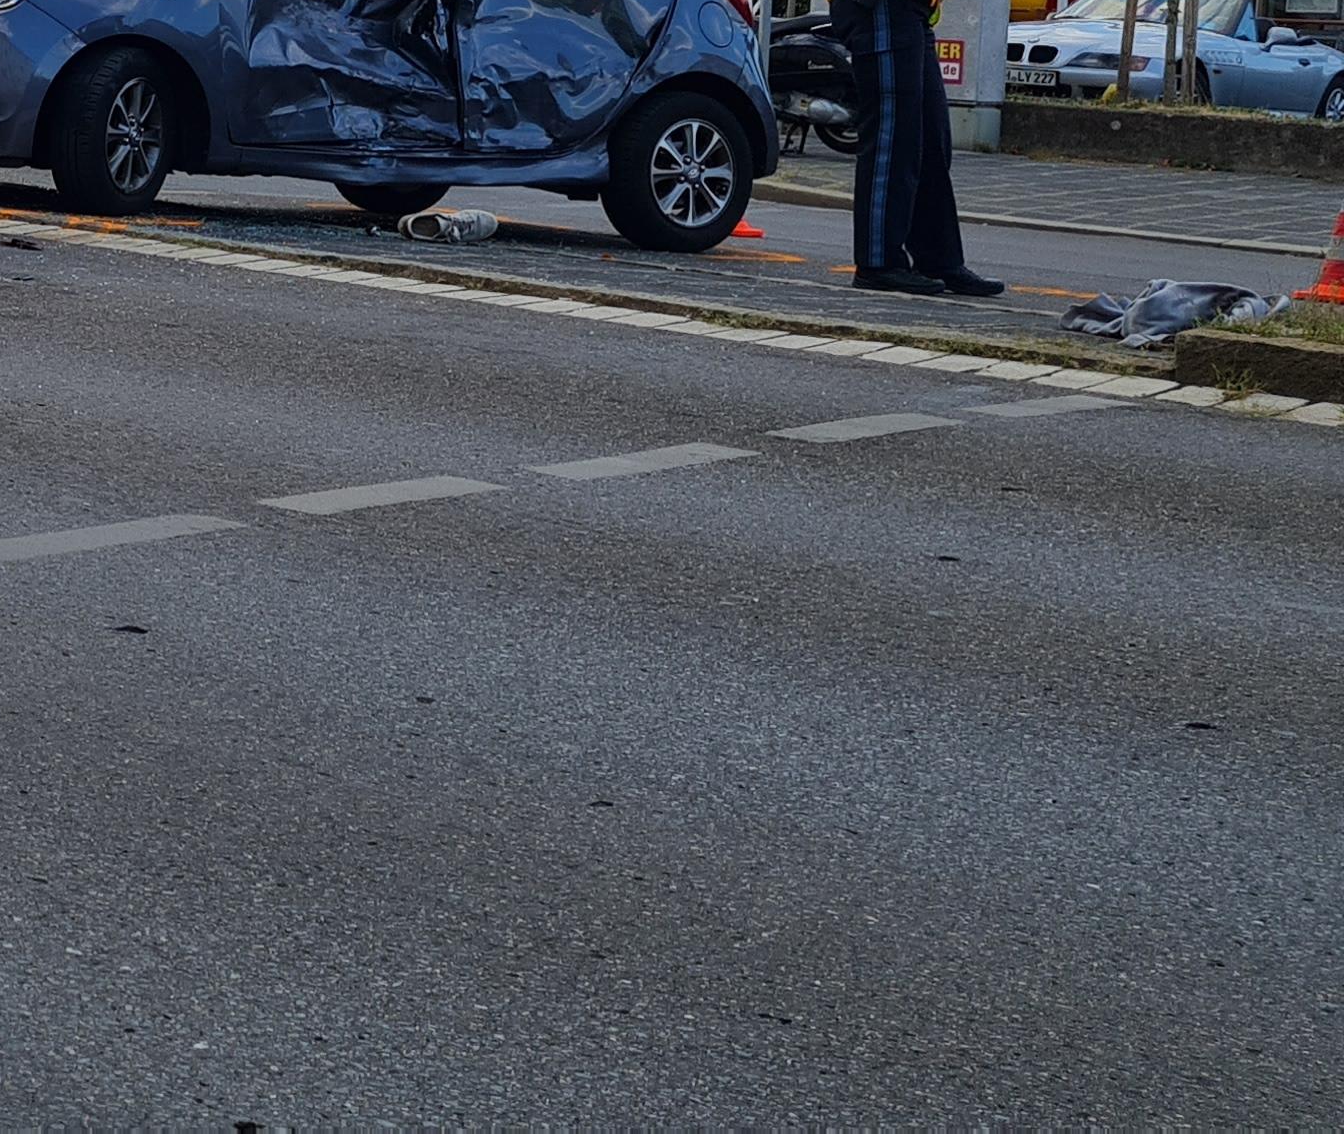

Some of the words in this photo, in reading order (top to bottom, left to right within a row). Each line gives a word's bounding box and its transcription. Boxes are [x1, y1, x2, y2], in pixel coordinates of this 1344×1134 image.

[935, 42, 961, 59] ER
[1017, 71, 1031, 82] LY
[1033, 72, 1054, 84] 227
